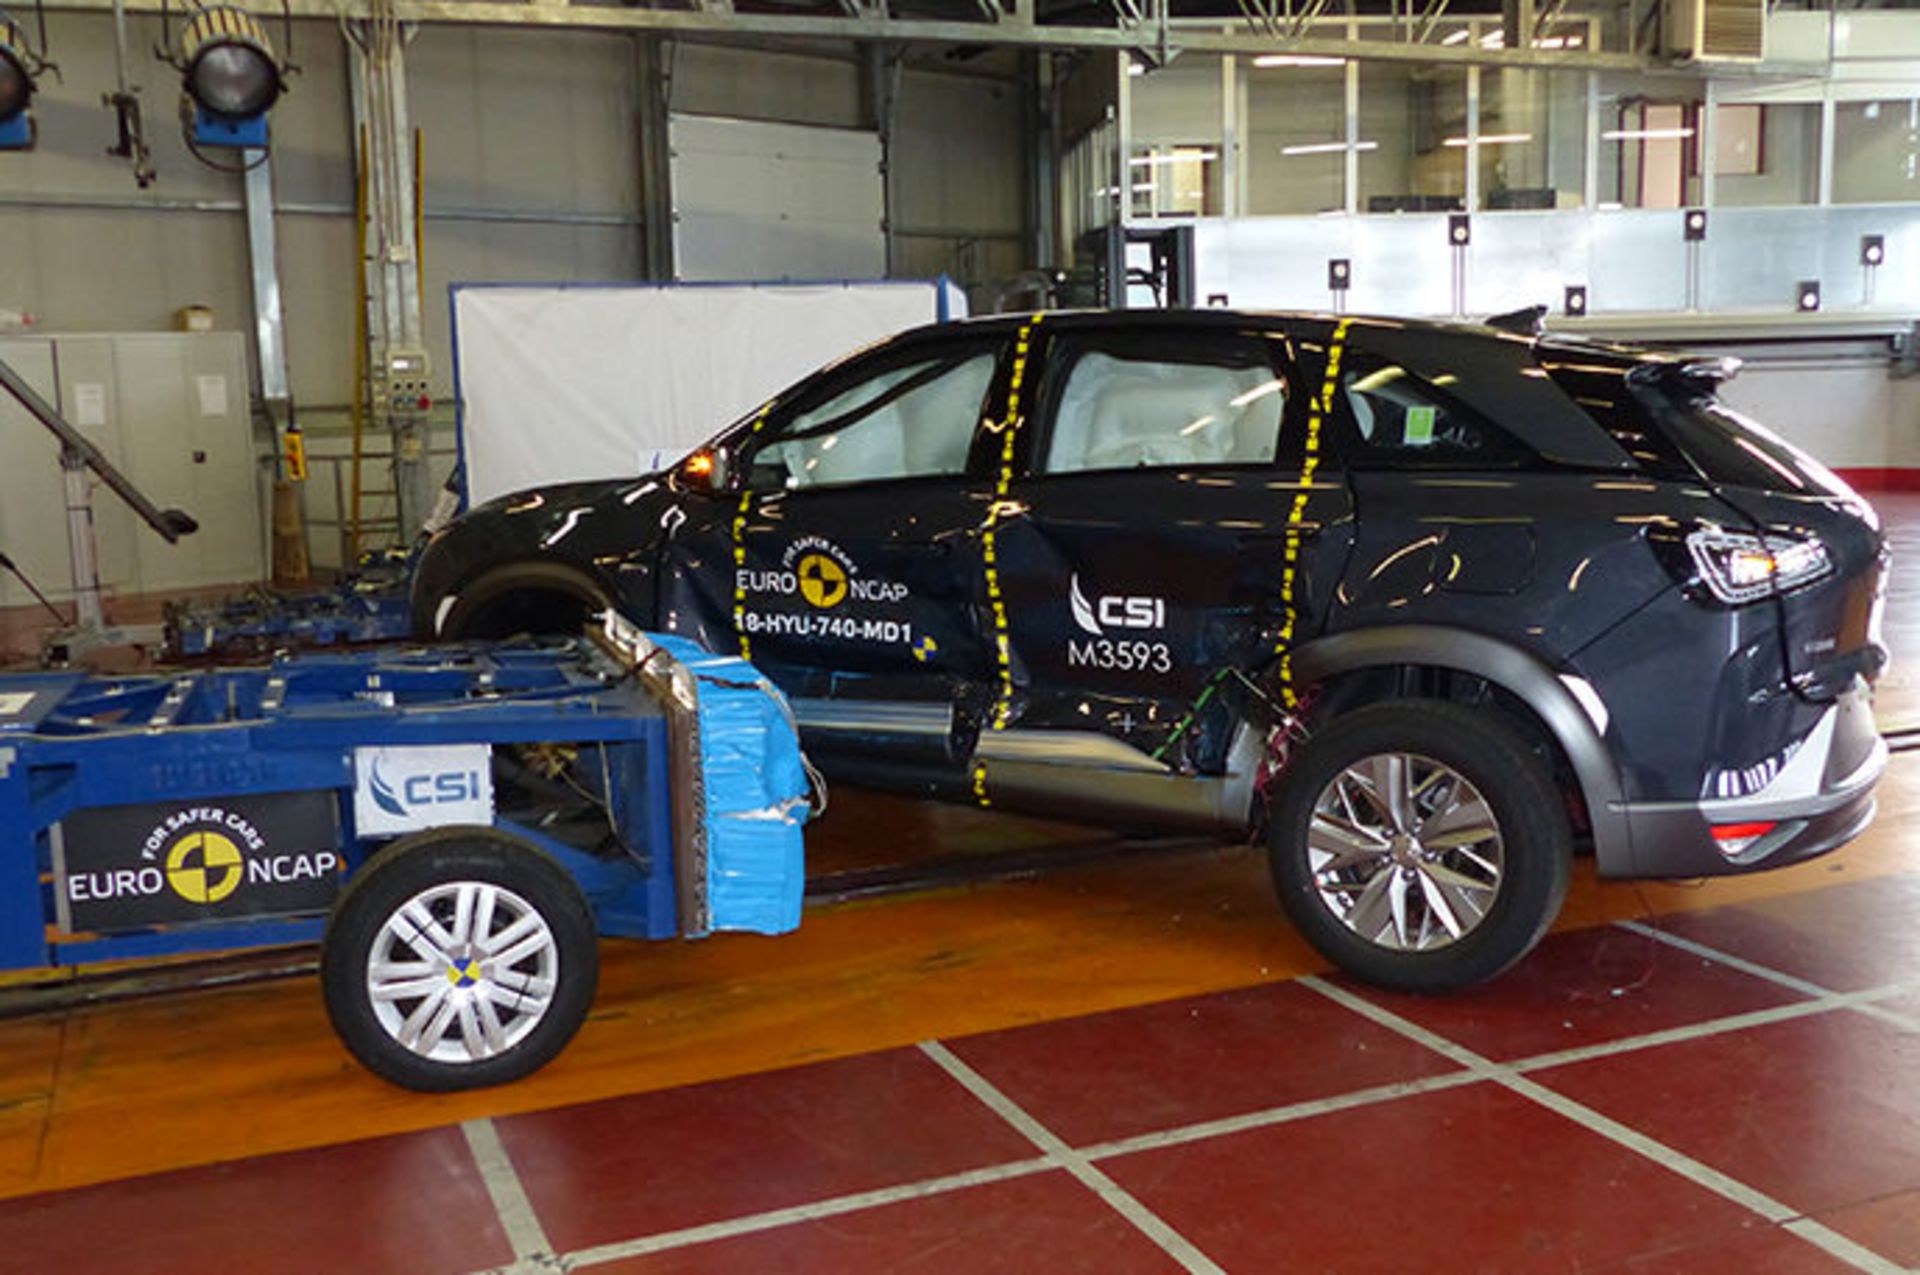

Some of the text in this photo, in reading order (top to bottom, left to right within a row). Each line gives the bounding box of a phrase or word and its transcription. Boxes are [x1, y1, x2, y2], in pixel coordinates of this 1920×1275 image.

[736, 569, 909, 602] EURO NCAP
[734, 611, 912, 643] 18-HYU-740-MD1
[1099, 596, 1165, 628] CSI
[1068, 639, 1172, 673] M3593
[405, 770, 480, 804] CSI
[141, 807, 266, 860] FOR SAFER CARS
[68, 852, 337, 901] EURO NCAP
